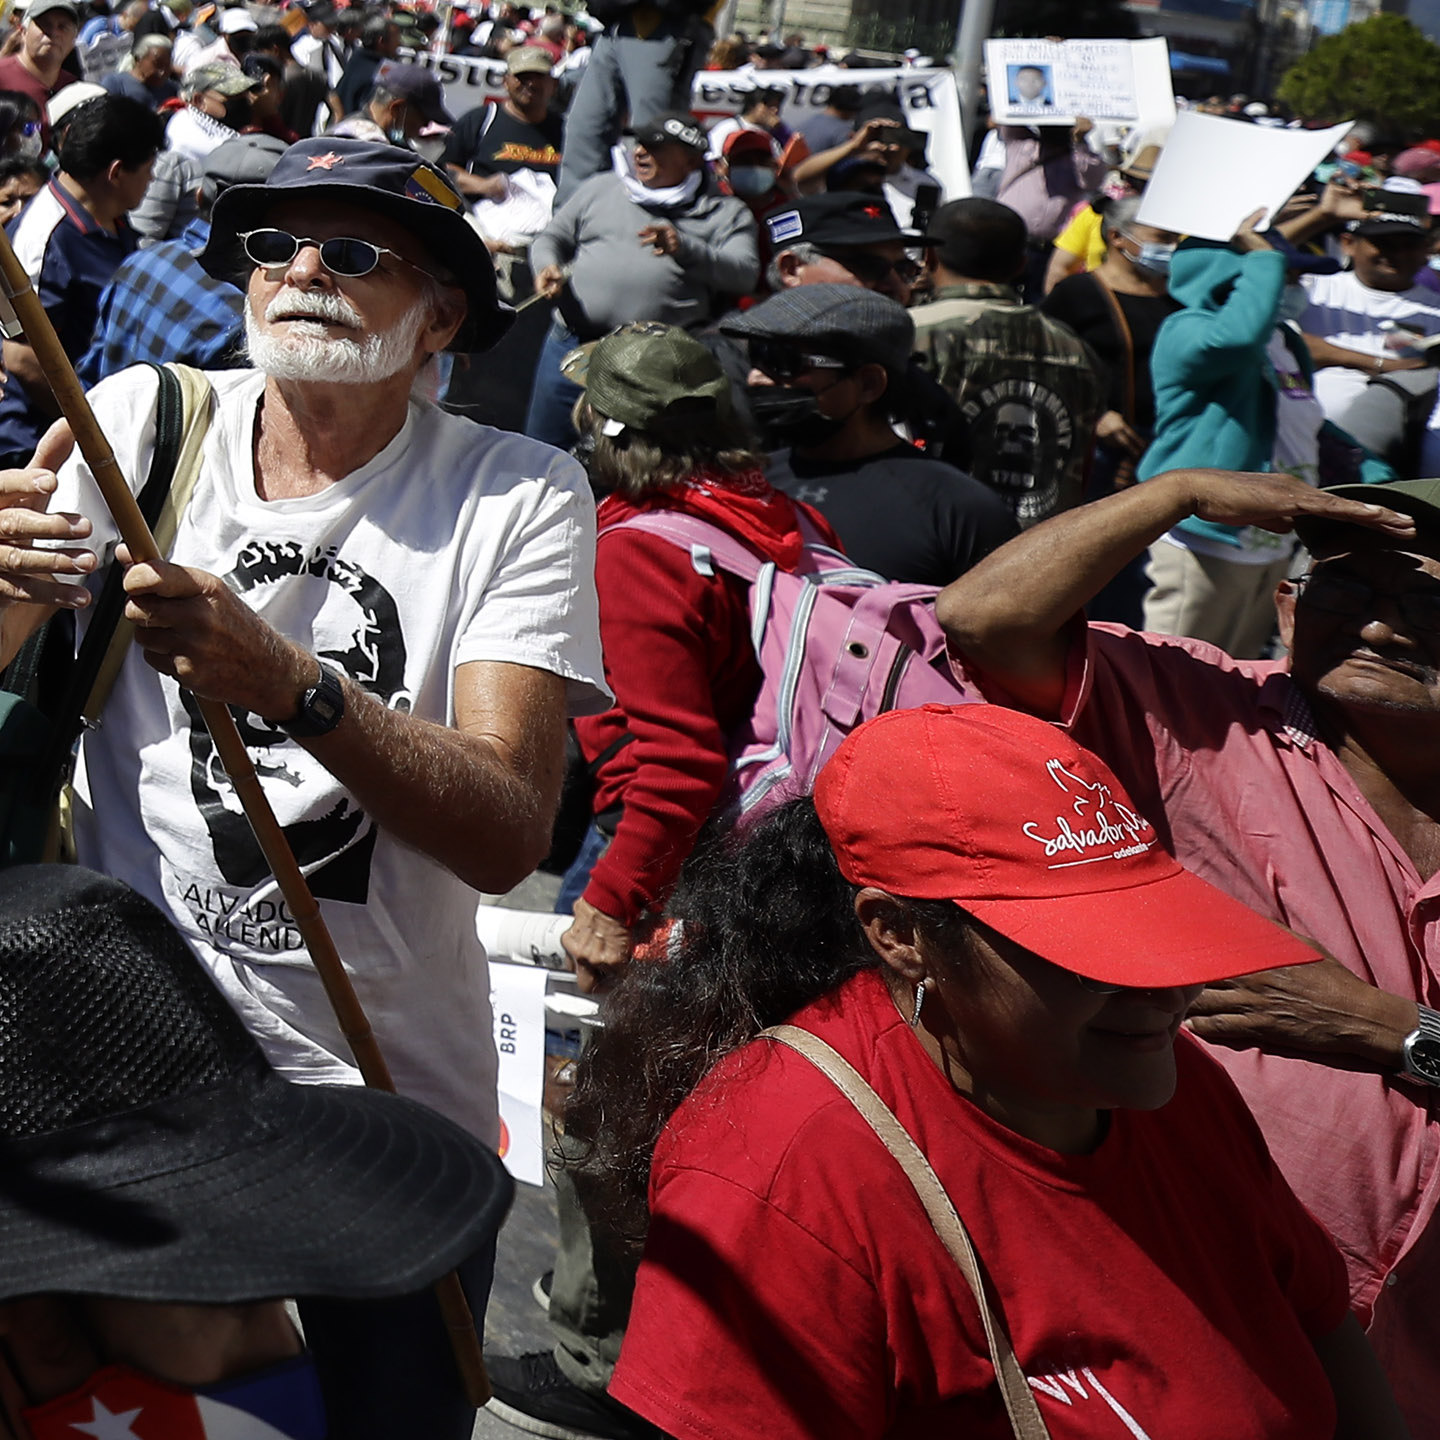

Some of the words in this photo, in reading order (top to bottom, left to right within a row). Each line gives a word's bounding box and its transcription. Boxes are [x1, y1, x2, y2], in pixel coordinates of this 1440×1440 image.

[1022, 810, 1125, 857] Salvador
[196, 912, 305, 952] ALLEND
[499, 1012, 519, 1056] BRP
